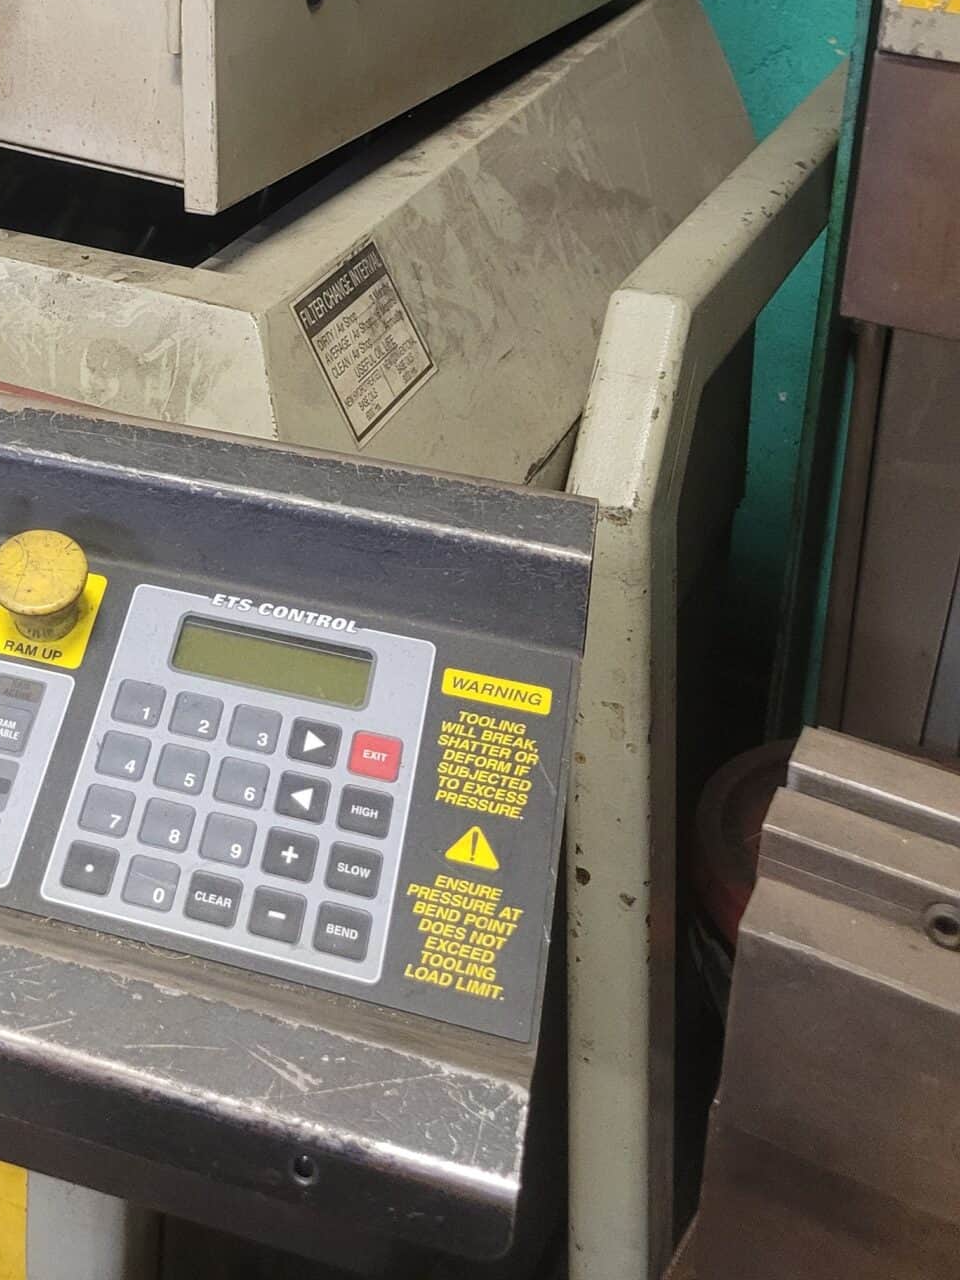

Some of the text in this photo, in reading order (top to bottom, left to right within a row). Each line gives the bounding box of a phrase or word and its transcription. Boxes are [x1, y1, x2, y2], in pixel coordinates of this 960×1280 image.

[298, 295, 328, 329] FILTER
[320, 272, 354, 310] CHANGE
[316, 328, 336, 351] DIRTY
[323, 334, 351, 365] AVERAGE
[330, 355, 351, 379] CLEAN
[211, 593, 360, 634] ETS CONTROL
[3, 640, 63, 661] RAM UP
[452, 676, 543, 706] WARNING
[142, 706, 151, 720] 1
[459, 711, 527, 735] TOOLING
[198, 719, 210, 733] 2
[441, 721, 539, 753] WILL BREAK,
[256, 733, 268, 747] 3
[437, 735, 539, 765] SHATTER OR
[124, 759, 136, 774] 4
[362, 749, 389, 763] EXIT
[443, 749, 531, 776] DEFORM IF
[184, 773, 195, 787] 5
[437, 762, 532, 792] SUBJECTED
[244, 787, 255, 801] 6
[438, 775, 529, 806] TO EXCESS
[351, 805, 379, 820] HIGH
[435, 790, 524, 820] PRESSURE.
[110, 815, 122, 829] 7
[168, 829, 180, 844] 8
[230, 844, 242, 858] 9
[337, 862, 371, 879] SLOW
[153, 888, 165, 904] 0
[434, 874, 503, 901] ENSURE
[194, 891, 232, 909] CLEAR
[406, 883, 524, 922] PRESSURE AT
[412, 901, 518, 937] BEND POINT
[326, 923, 359, 941] BEND
[417, 918, 507, 951] DOES NOT
[424, 936, 495, 964] EXCEED
[420, 951, 497, 982] TOOLING
[404, 963, 505, 1001] LOAD LIMIT.
